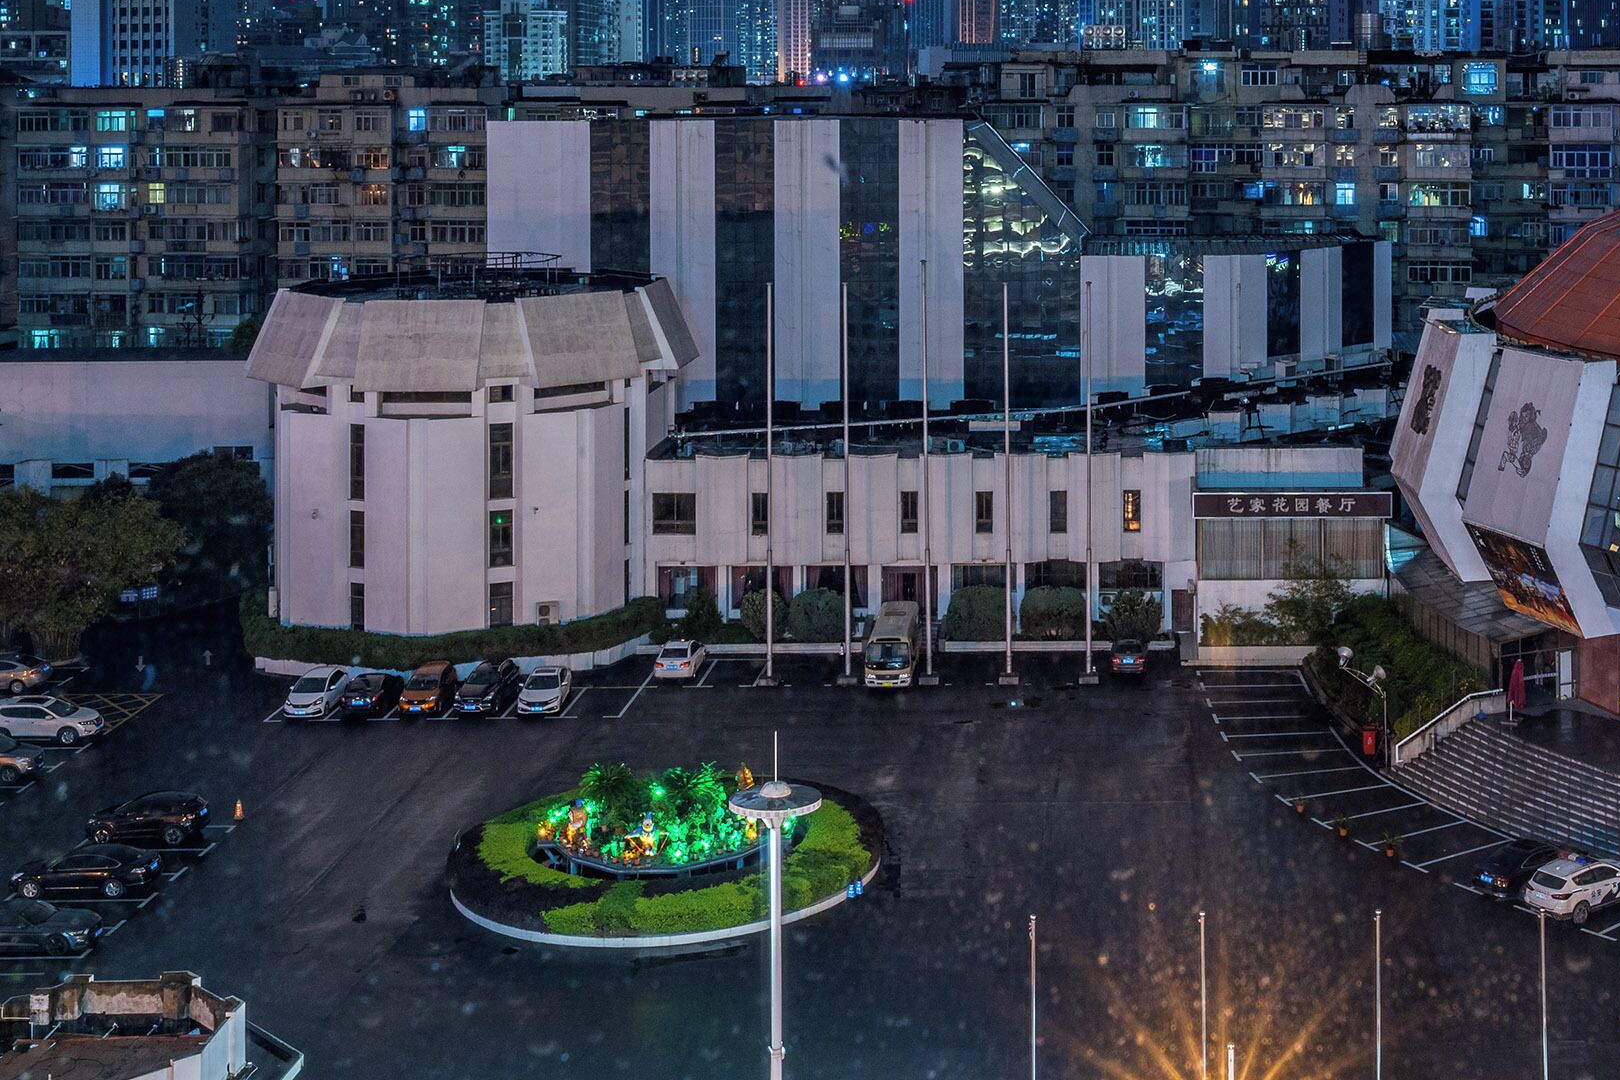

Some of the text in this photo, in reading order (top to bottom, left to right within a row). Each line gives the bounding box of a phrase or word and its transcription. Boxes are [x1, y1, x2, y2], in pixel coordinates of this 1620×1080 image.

[1226, 496, 1357, 514] 艺家花园餐厅
